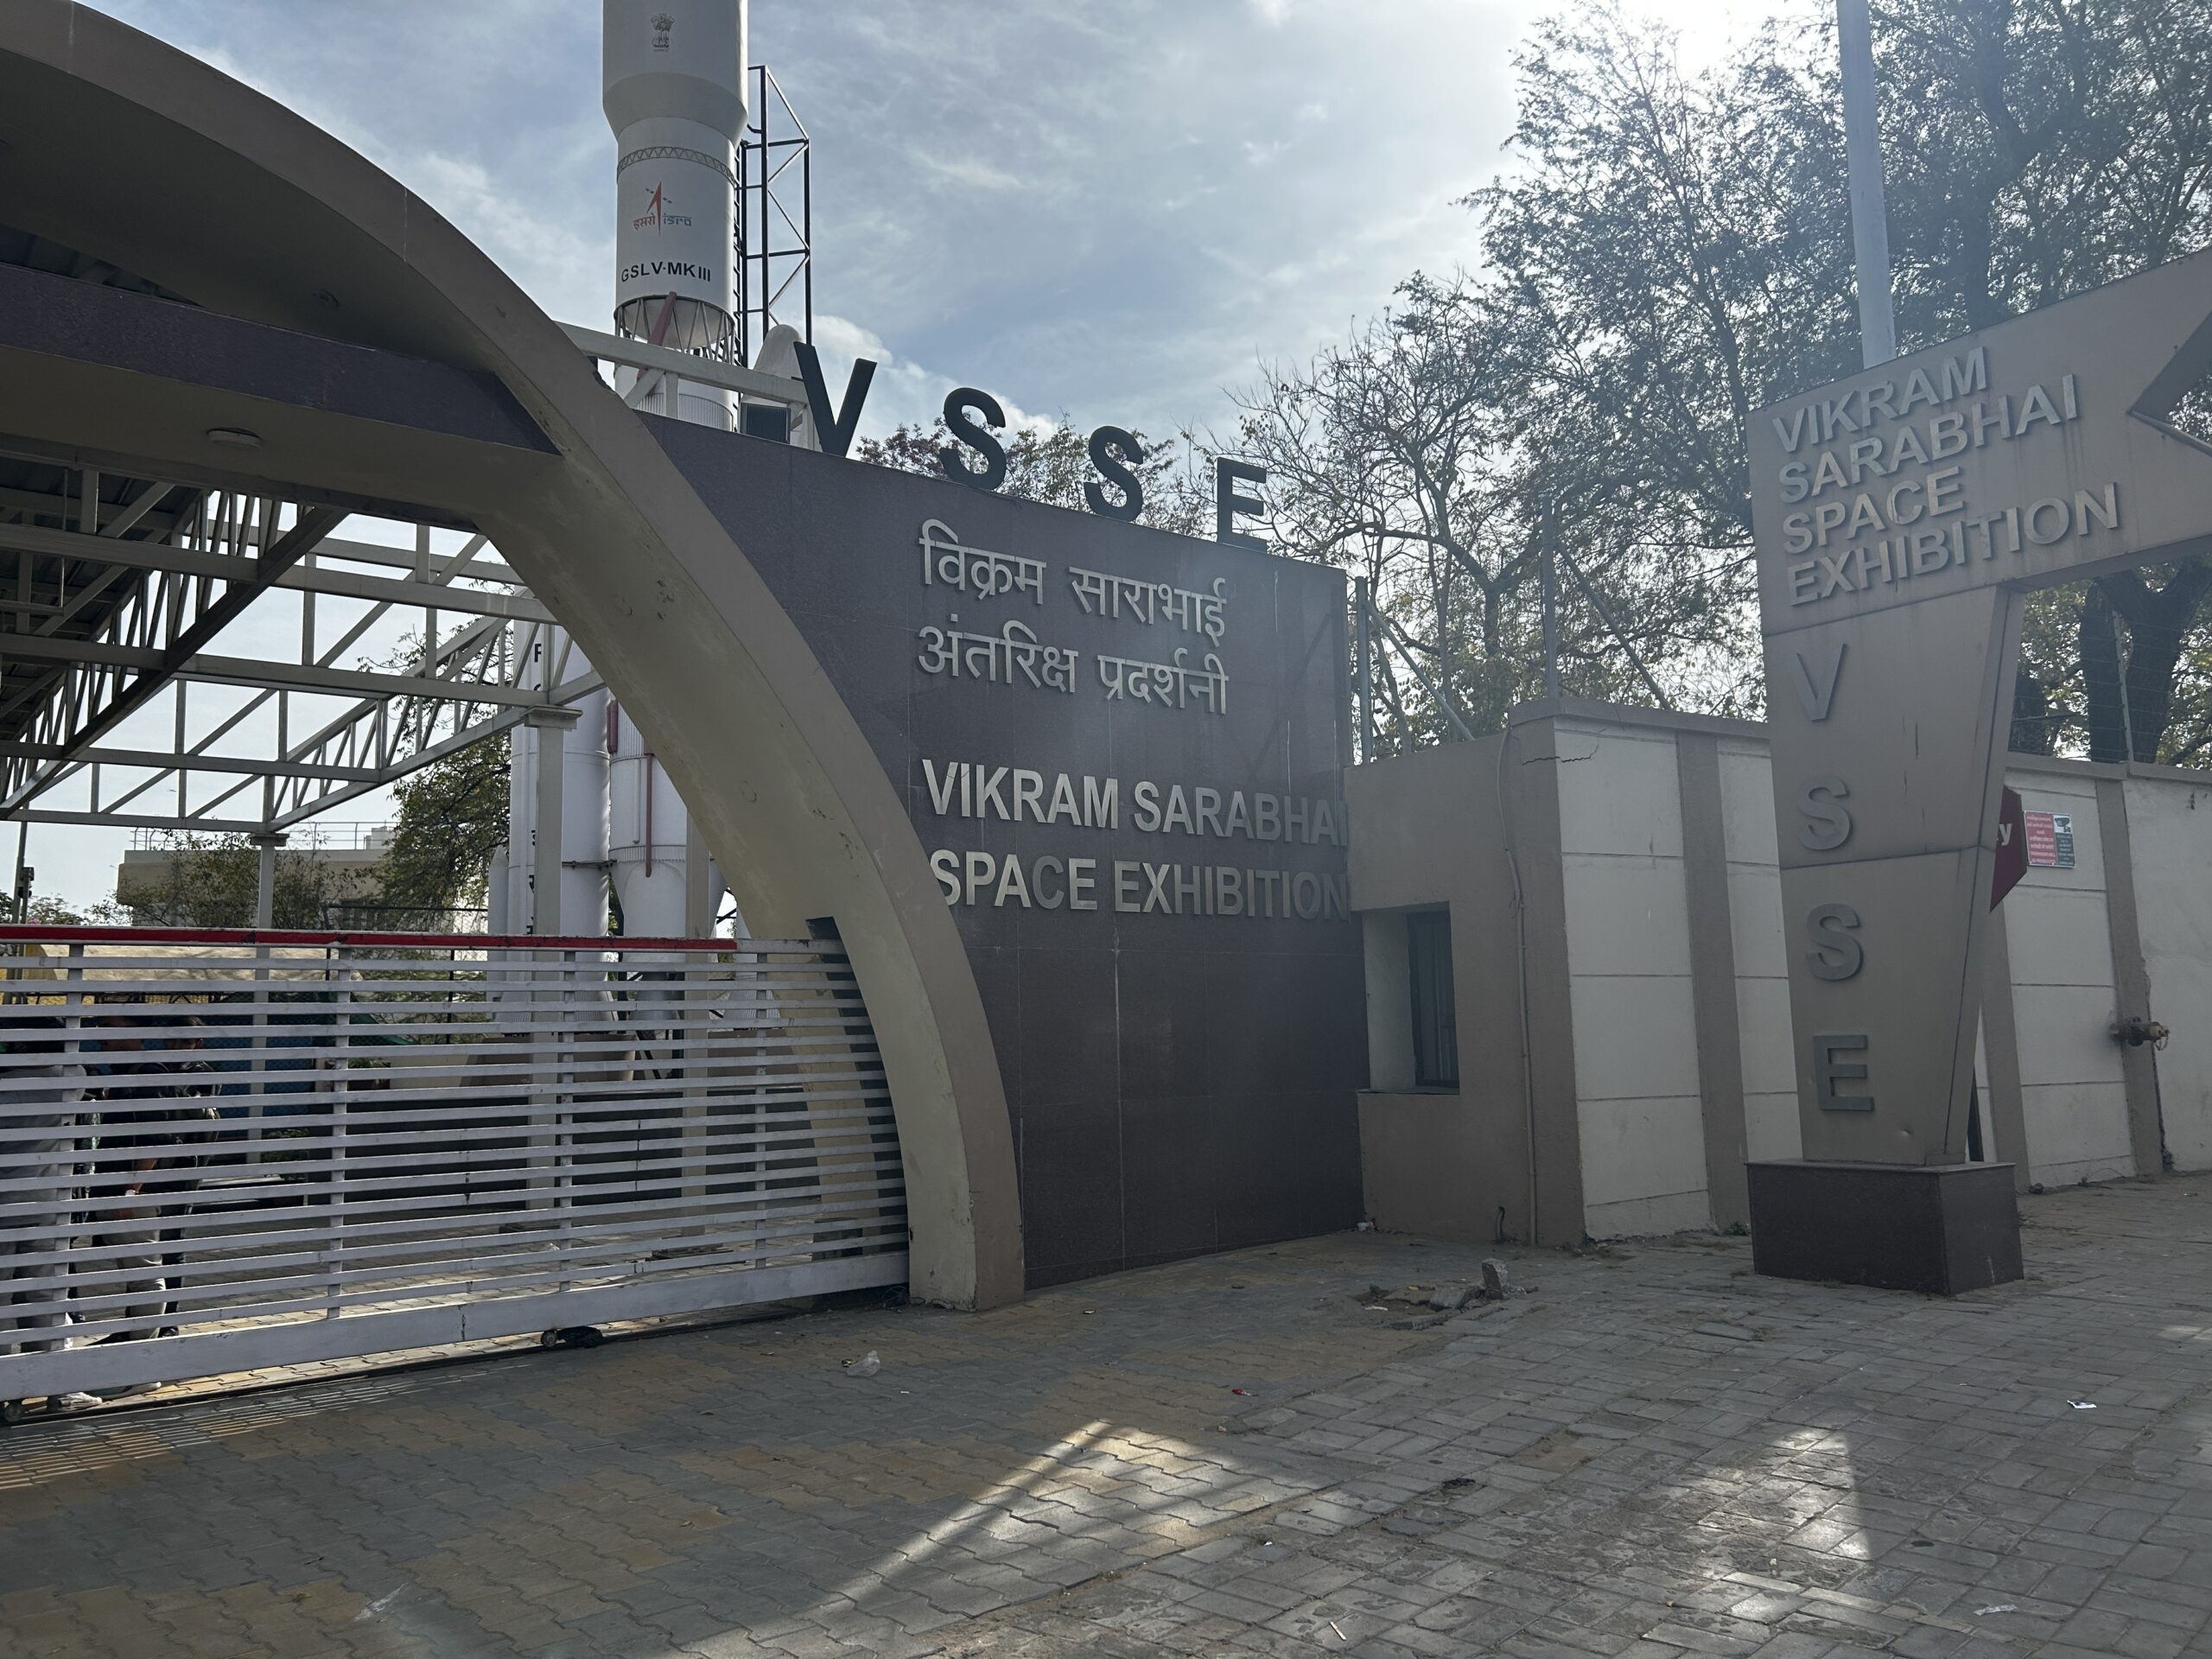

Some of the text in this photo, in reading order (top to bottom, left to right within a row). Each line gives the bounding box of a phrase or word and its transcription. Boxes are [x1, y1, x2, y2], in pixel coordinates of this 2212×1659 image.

[632, 212, 656, 231] इसरो
[1773, 346, 1989, 454] VIKRAM
[1778, 373, 2078, 503] SARABHAI
[1783, 466, 1965, 554] SPACE
[1788, 481, 2119, 606] EXHIBITION
[918, 518, 1228, 647] विक्रम साराभाई
[918, 613, 1230, 715] अंतरिक्ष प्रदर्शनी
[922, 759, 1348, 847] VIKRAM SARABHAI
[930, 849, 1350, 922] SPACE EXHIBITION
